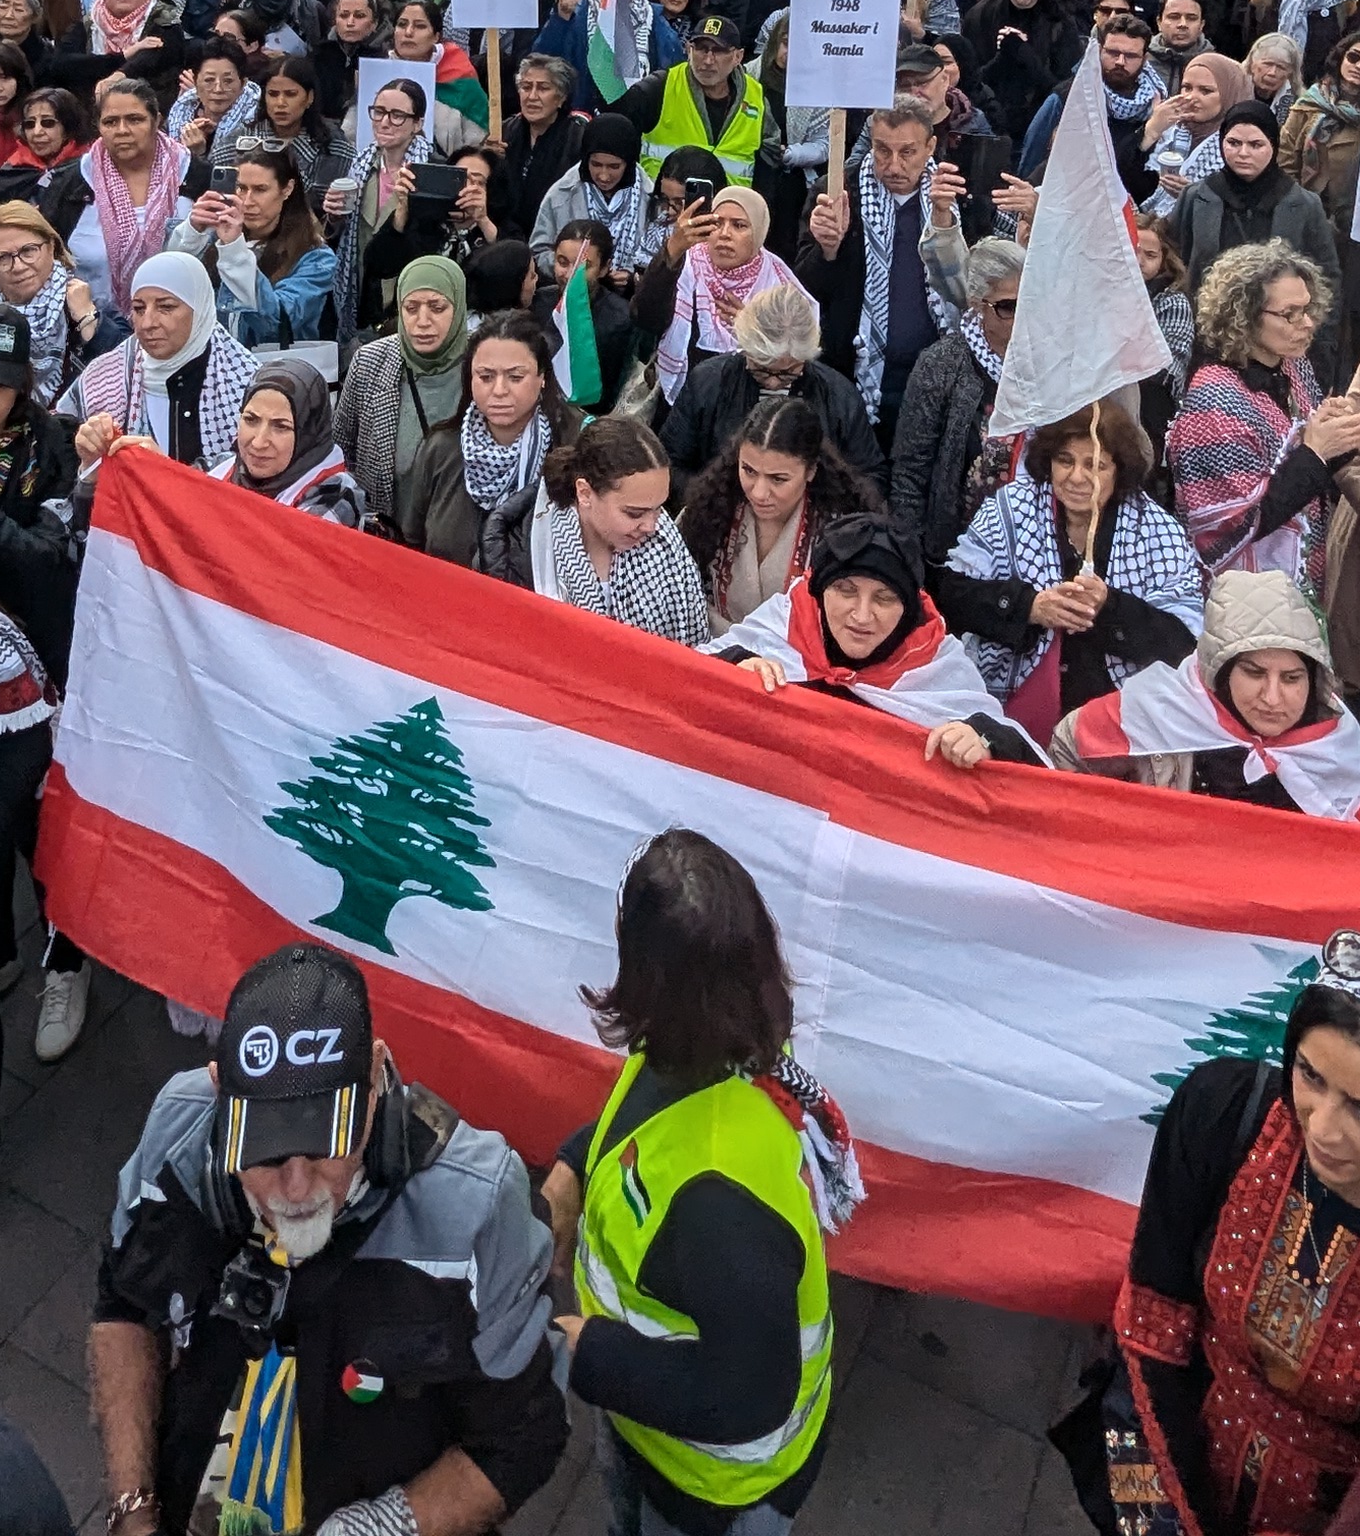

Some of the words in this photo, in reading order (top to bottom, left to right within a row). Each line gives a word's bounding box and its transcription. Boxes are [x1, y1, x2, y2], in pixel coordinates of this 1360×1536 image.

[810, 20, 871, 34] Massaker
[872, 21, 879, 35] i
[285, 1027, 344, 1066] CZ
